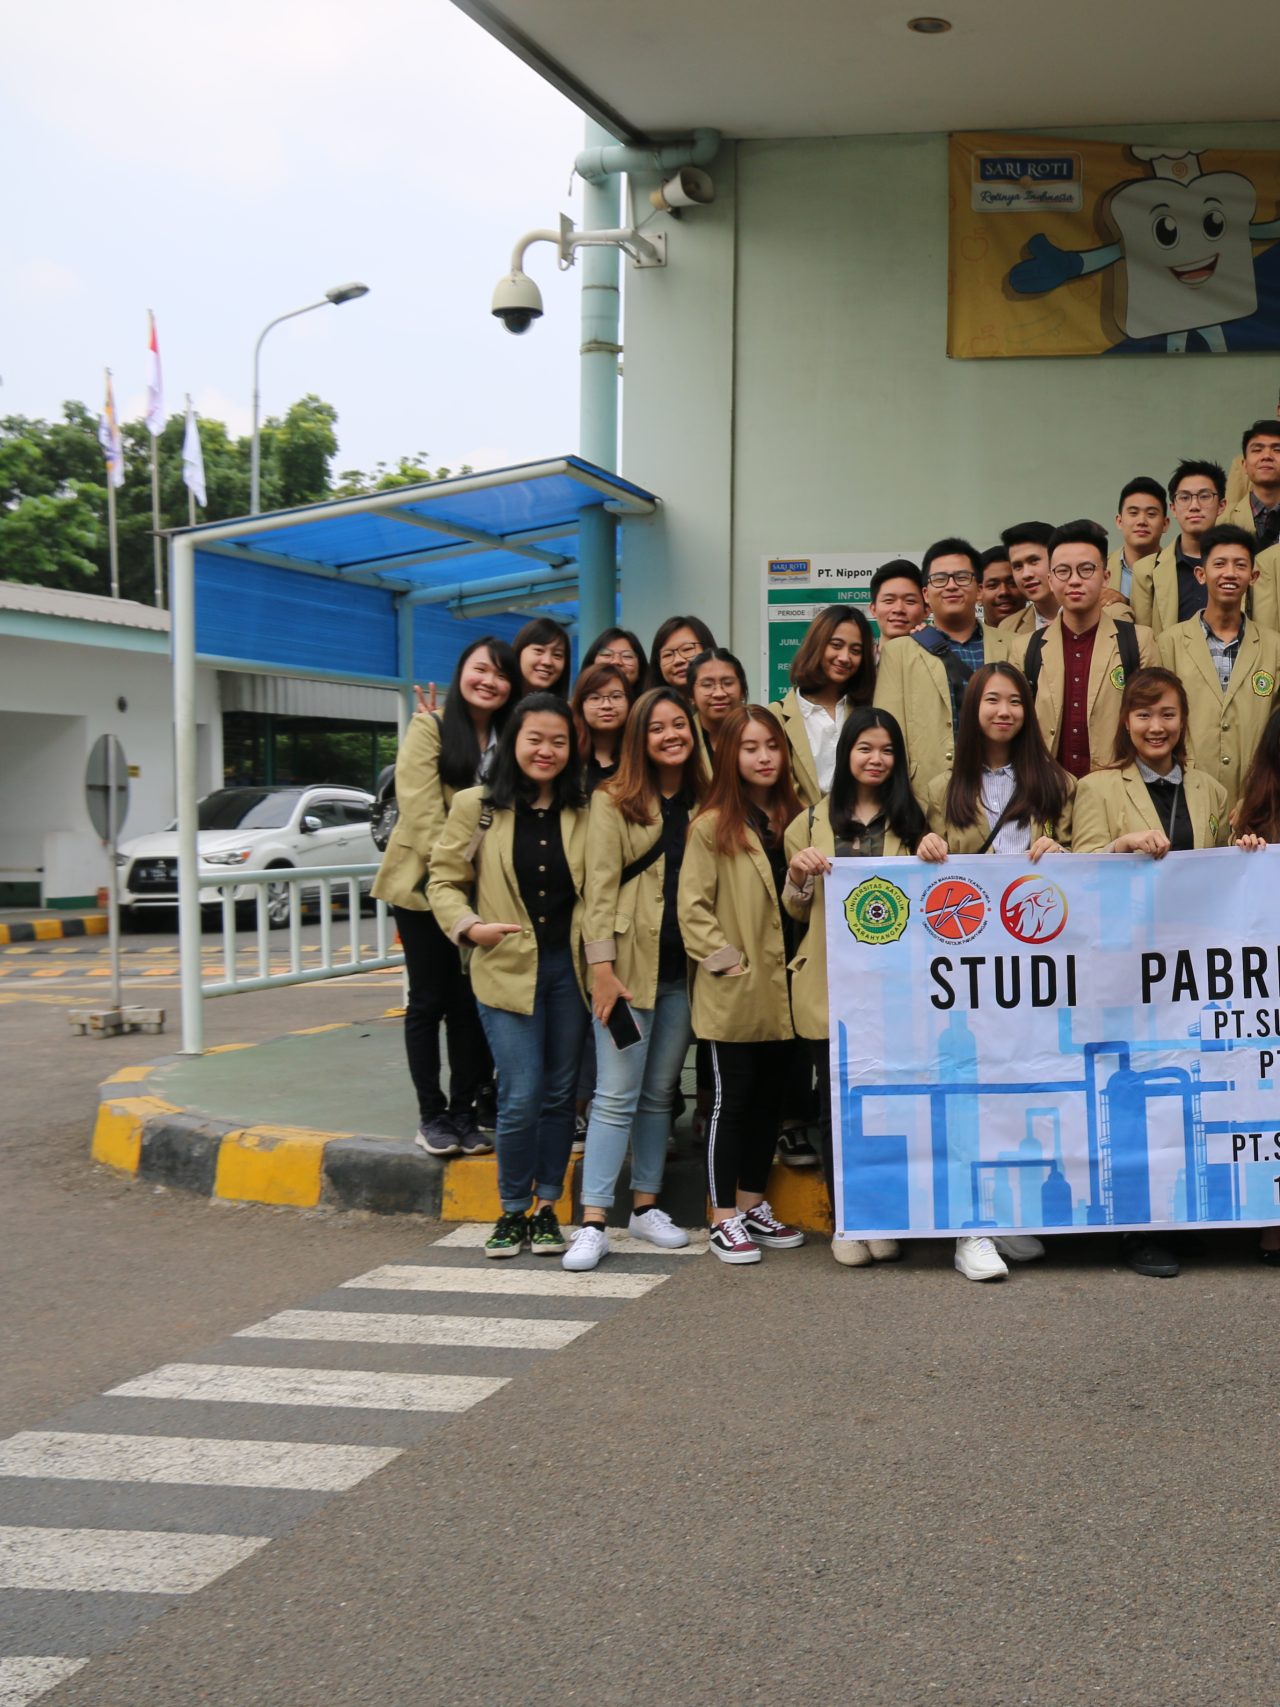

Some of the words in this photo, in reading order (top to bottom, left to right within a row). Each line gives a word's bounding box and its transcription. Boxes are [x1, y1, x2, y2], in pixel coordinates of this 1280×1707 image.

[985, 162, 1021, 178] SARI
[1027, 162, 1068, 177] ROTI
[817, 568, 833, 577] PT.
[836, 568, 872, 579] Nippon
[779, 639, 801, 647] JUML
[849, 883, 882, 912] UNIVERSITAS
[885, 886, 905, 911] KATOLIK
[852, 922, 902, 940] PARAHYANGAN
[930, 954, 1077, 1010] STUDI
